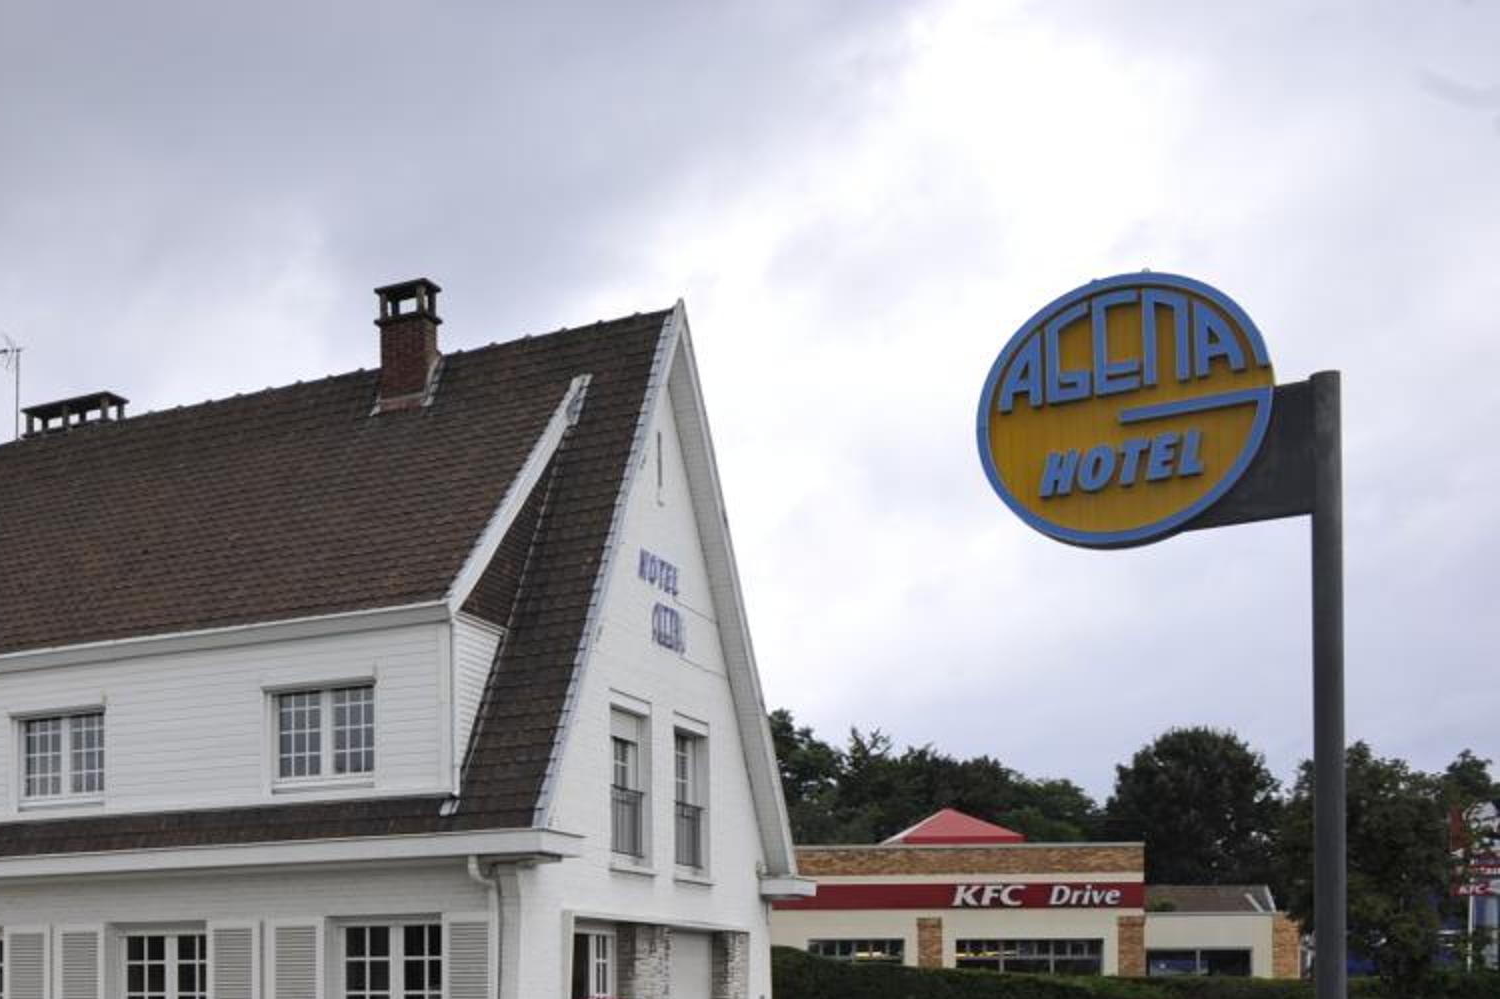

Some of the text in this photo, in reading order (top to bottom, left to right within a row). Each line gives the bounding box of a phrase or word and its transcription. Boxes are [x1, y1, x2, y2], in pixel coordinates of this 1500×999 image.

[997, 287, 1245, 413] AGENA
[1040, 431, 1204, 498] HOTEL
[638, 547, 679, 597] HOTEL
[952, 884, 1121, 907] KFC Drive
